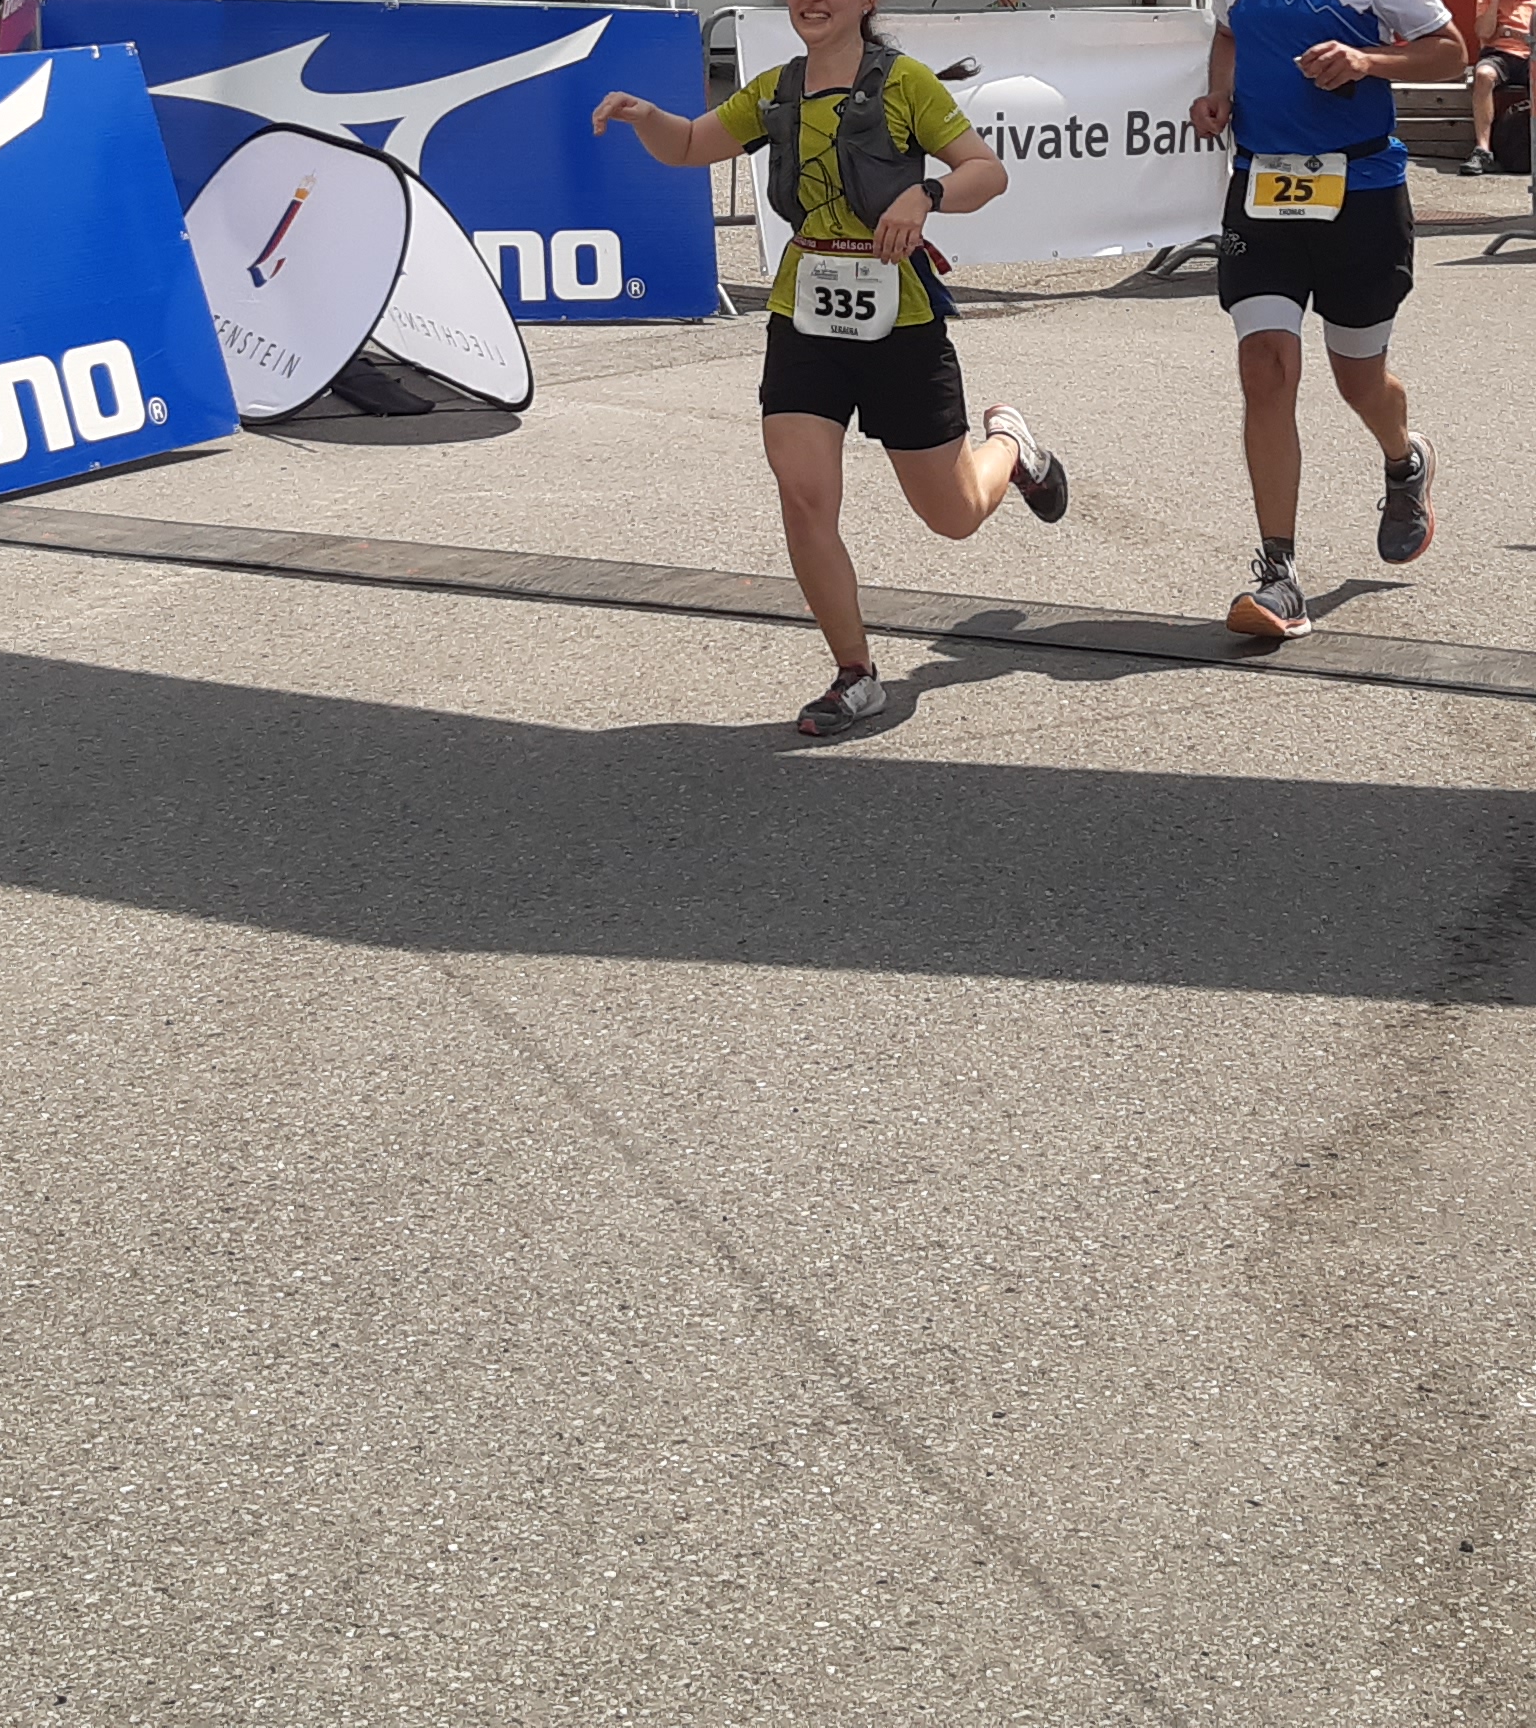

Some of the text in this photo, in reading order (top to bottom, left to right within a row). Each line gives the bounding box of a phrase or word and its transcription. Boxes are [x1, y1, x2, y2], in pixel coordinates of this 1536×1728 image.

[976, 112, 1109, 161] rivate
[1274, 175, 1314, 203] 25
[831, 240, 874, 251] Helsan
[814, 286, 877, 321] 335
